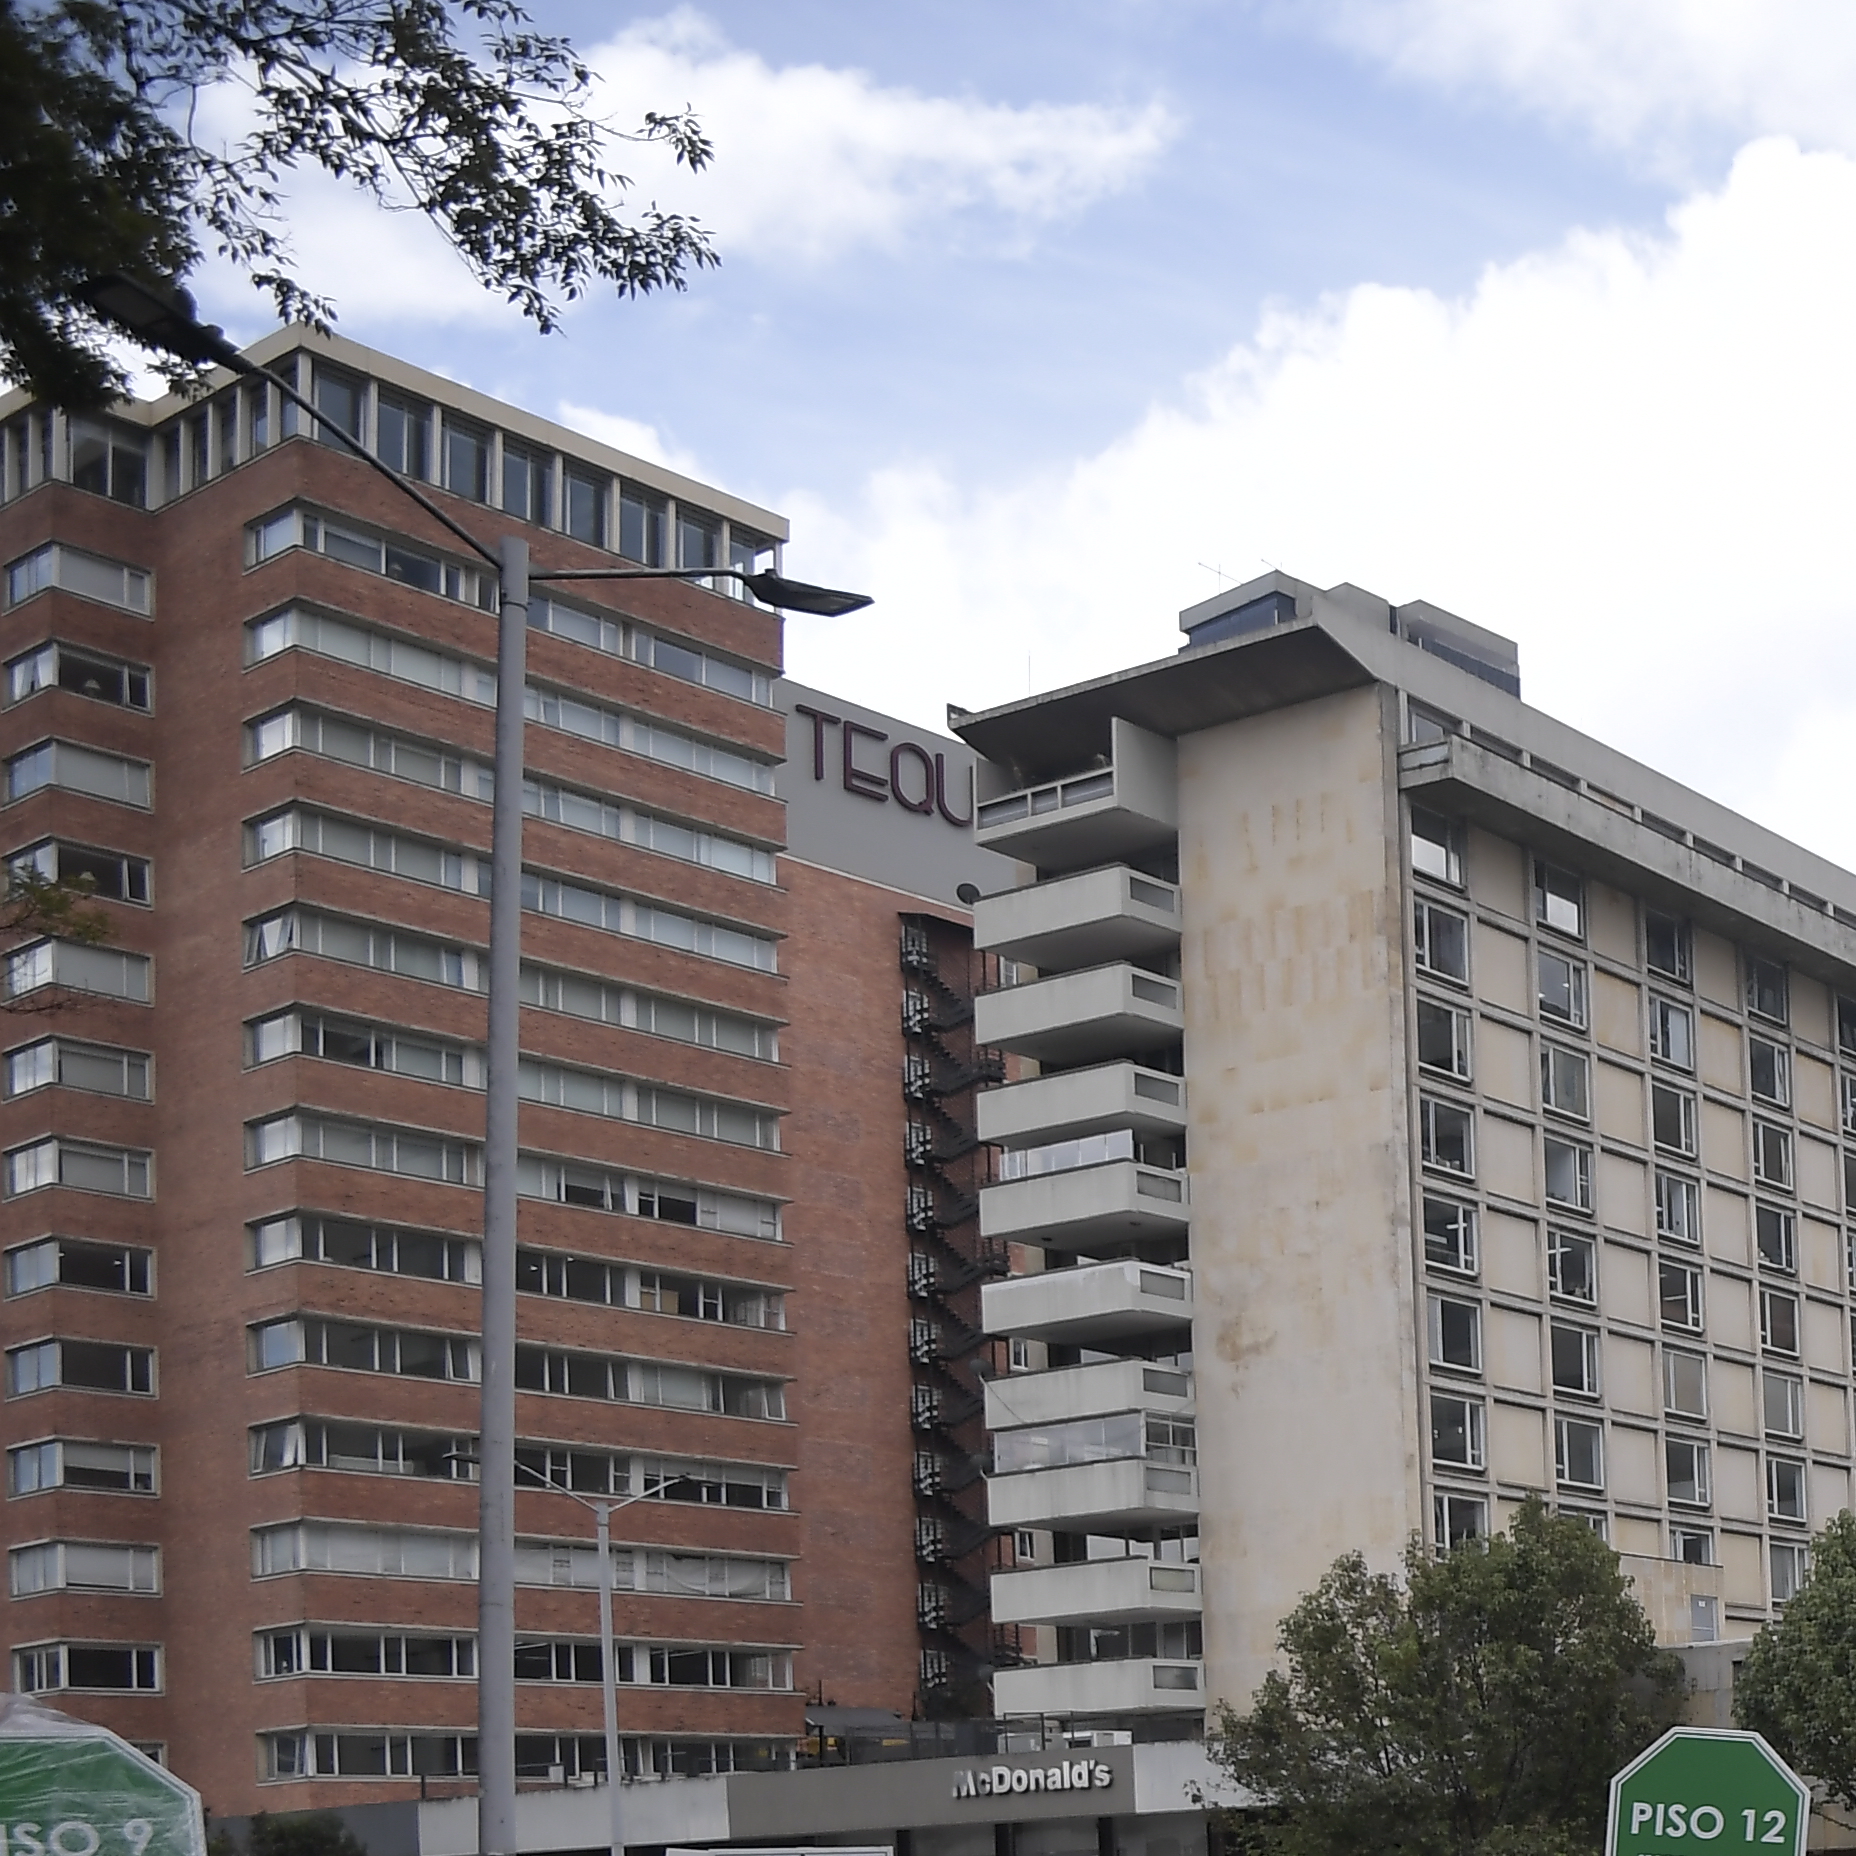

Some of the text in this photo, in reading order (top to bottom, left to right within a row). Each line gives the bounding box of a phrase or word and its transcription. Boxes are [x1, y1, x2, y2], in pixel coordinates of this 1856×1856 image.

[952, 1760, 1113, 1799] McDonald's
[123, 1818, 154, 1856] 9
[1630, 1801, 1787, 1844] PISO 12
